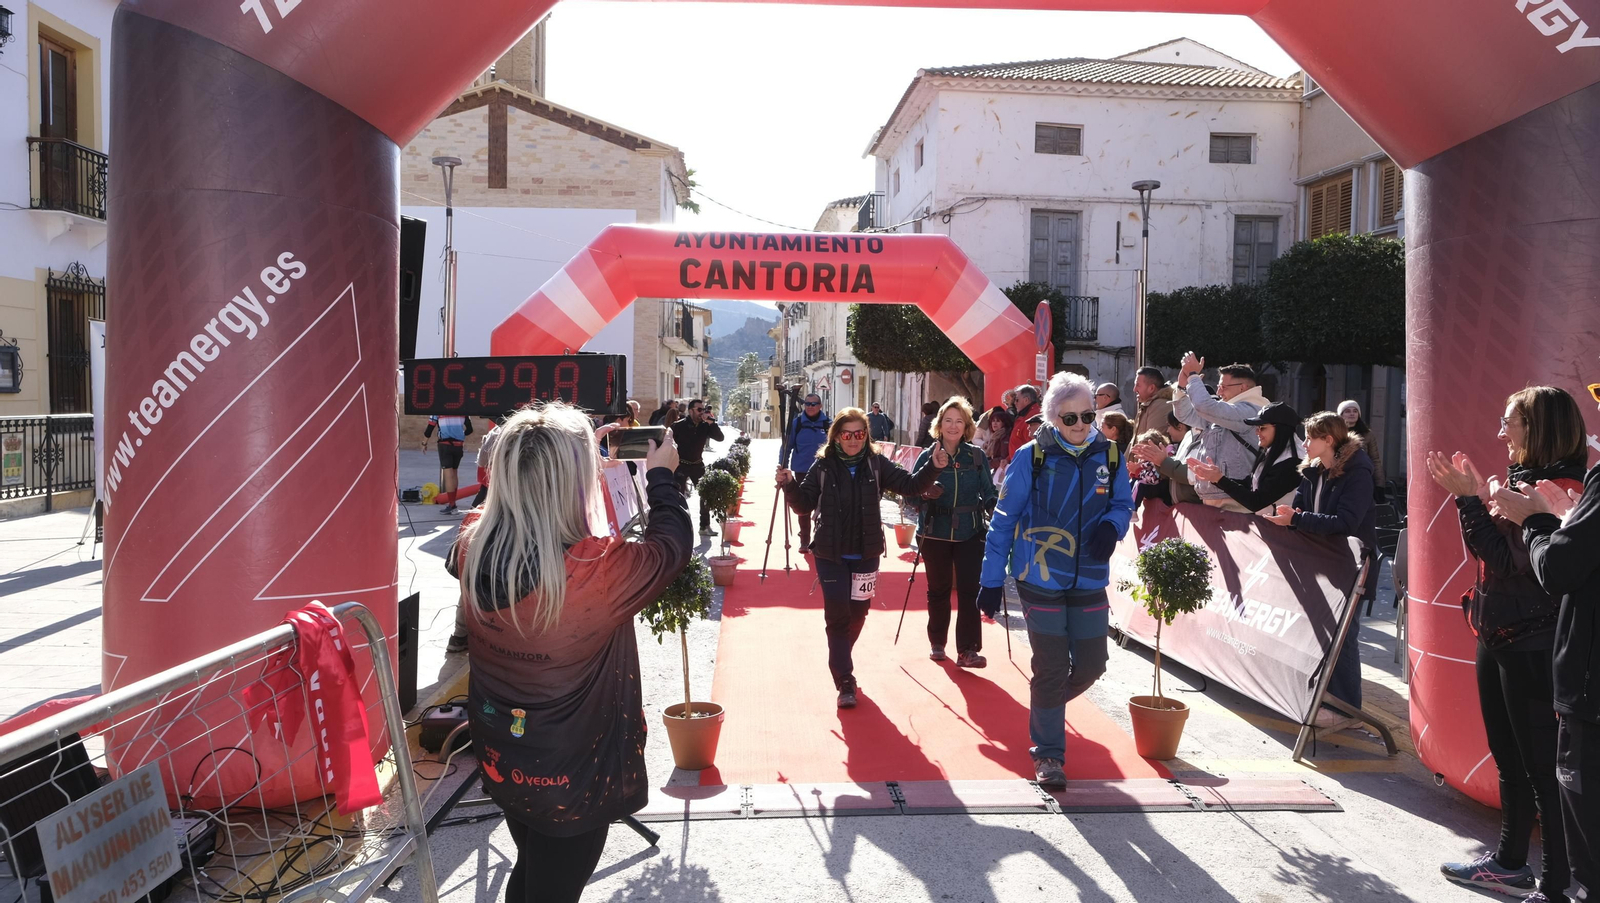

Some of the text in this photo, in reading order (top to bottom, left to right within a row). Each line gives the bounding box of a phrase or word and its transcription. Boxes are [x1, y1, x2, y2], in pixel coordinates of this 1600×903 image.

[674, 232, 884, 254] AYUNTAMIENTO
[679, 258, 875, 293] CANTORIA
[103, 251, 307, 516] www.teamergy.es
[1198, 586, 1302, 638] EAMERGY
[489, 644, 552, 661] ALMANZORA
[525, 775, 570, 787] VEOLIA
[56, 772, 155, 850] ALYSER DE
[121, 868, 147, 898] 453
[149, 851, 173, 879] 550
